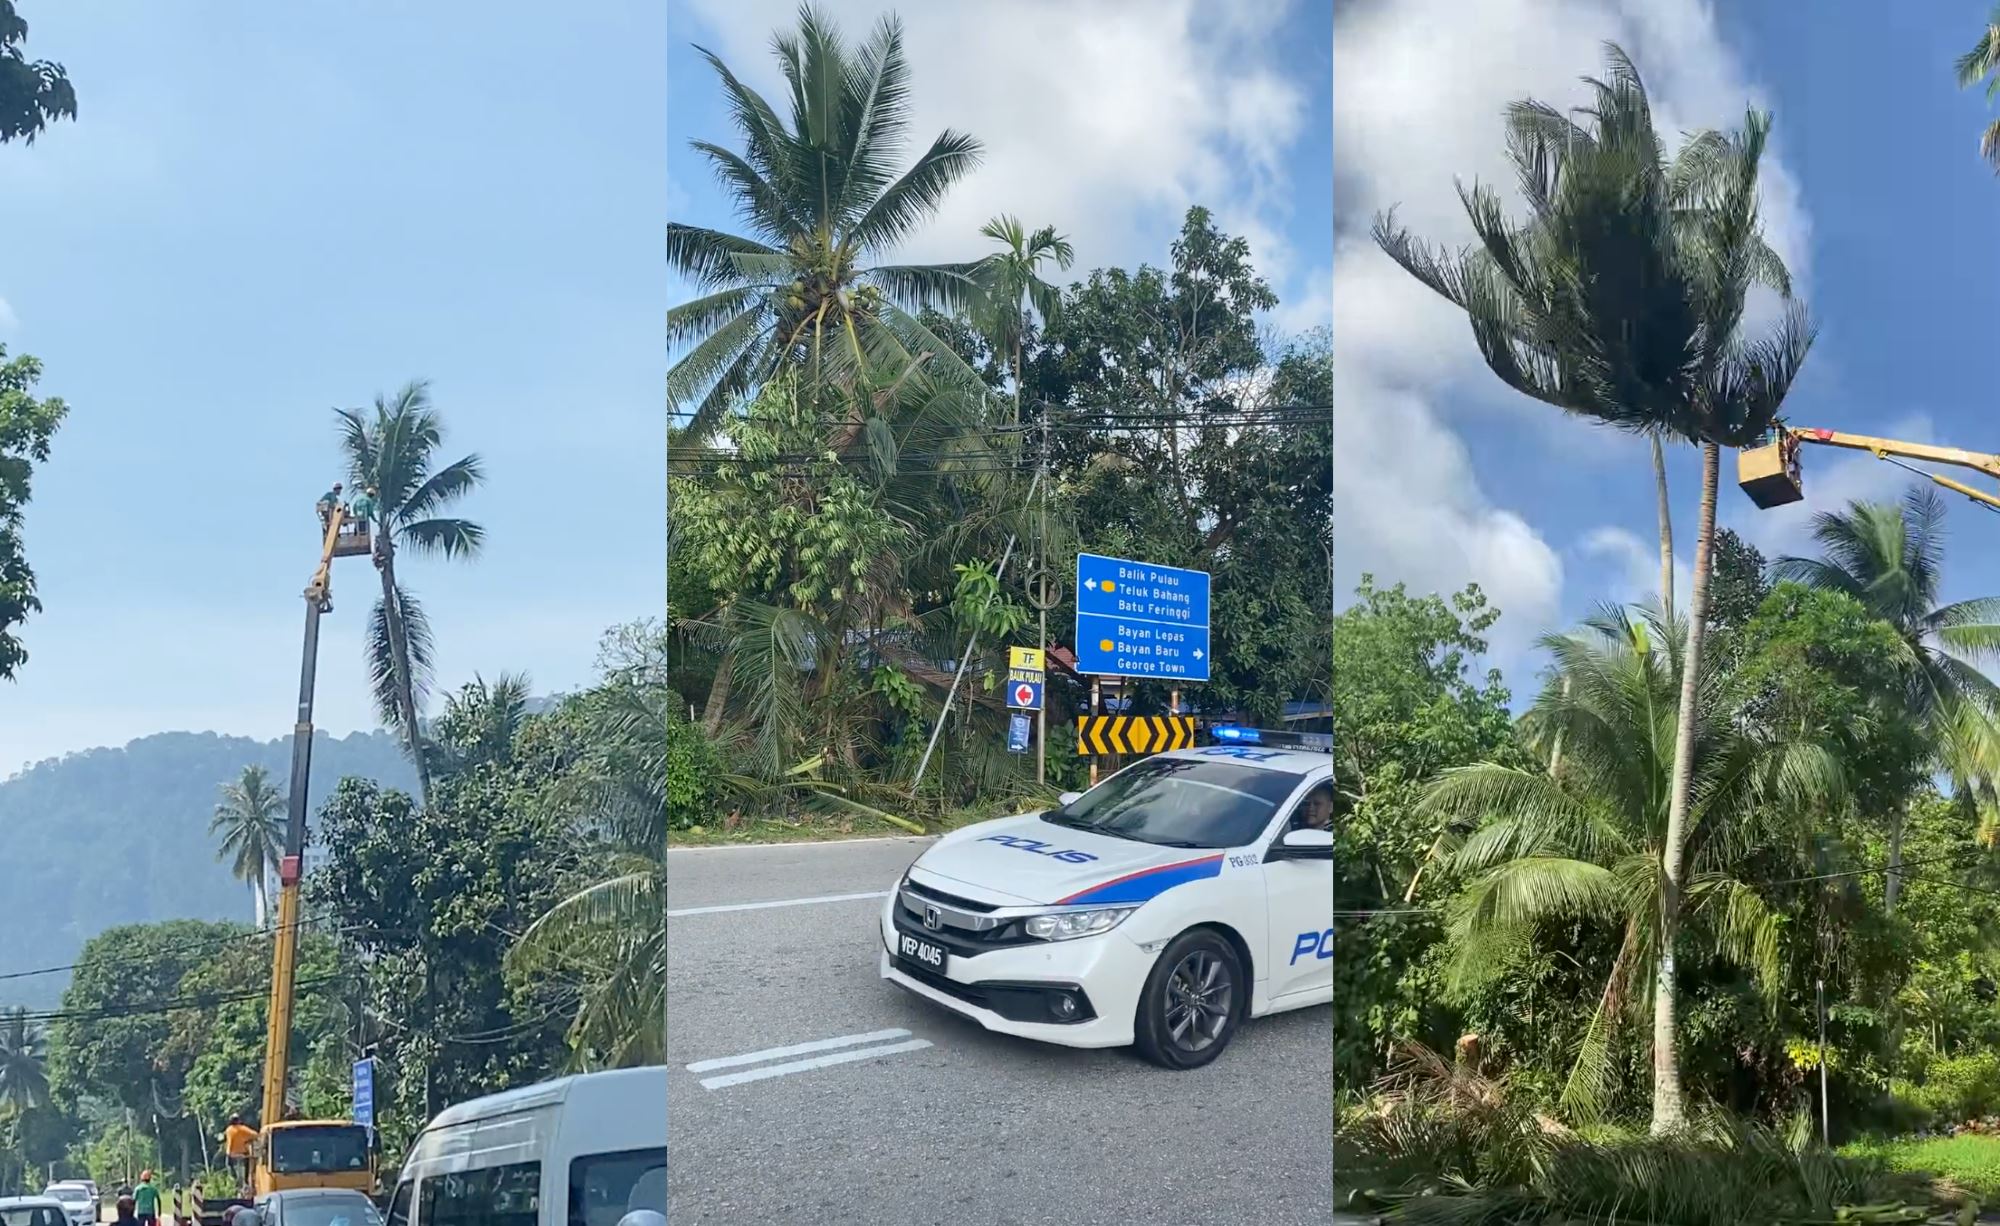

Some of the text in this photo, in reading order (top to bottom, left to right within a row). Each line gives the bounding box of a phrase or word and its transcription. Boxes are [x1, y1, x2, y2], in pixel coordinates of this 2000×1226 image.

[1119, 567, 1179, 586] Balik Pulau
[1119, 583, 1190, 605] Teluk Bahang
[1118, 599, 1191, 619] Batu Feringgi
[1118, 624, 1185, 643] Bayan Lepas
[1022, 652, 1036, 664] TF
[1117, 641, 1180, 657] Bayan Baru
[1117, 657, 1185, 673] George Town
[1009, 668, 1043, 684] BALIK PULAU
[975, 835, 1099, 864] POLIS
[1229, 855, 1244, 868] PG
[901, 934, 942, 966] VEP 4045
